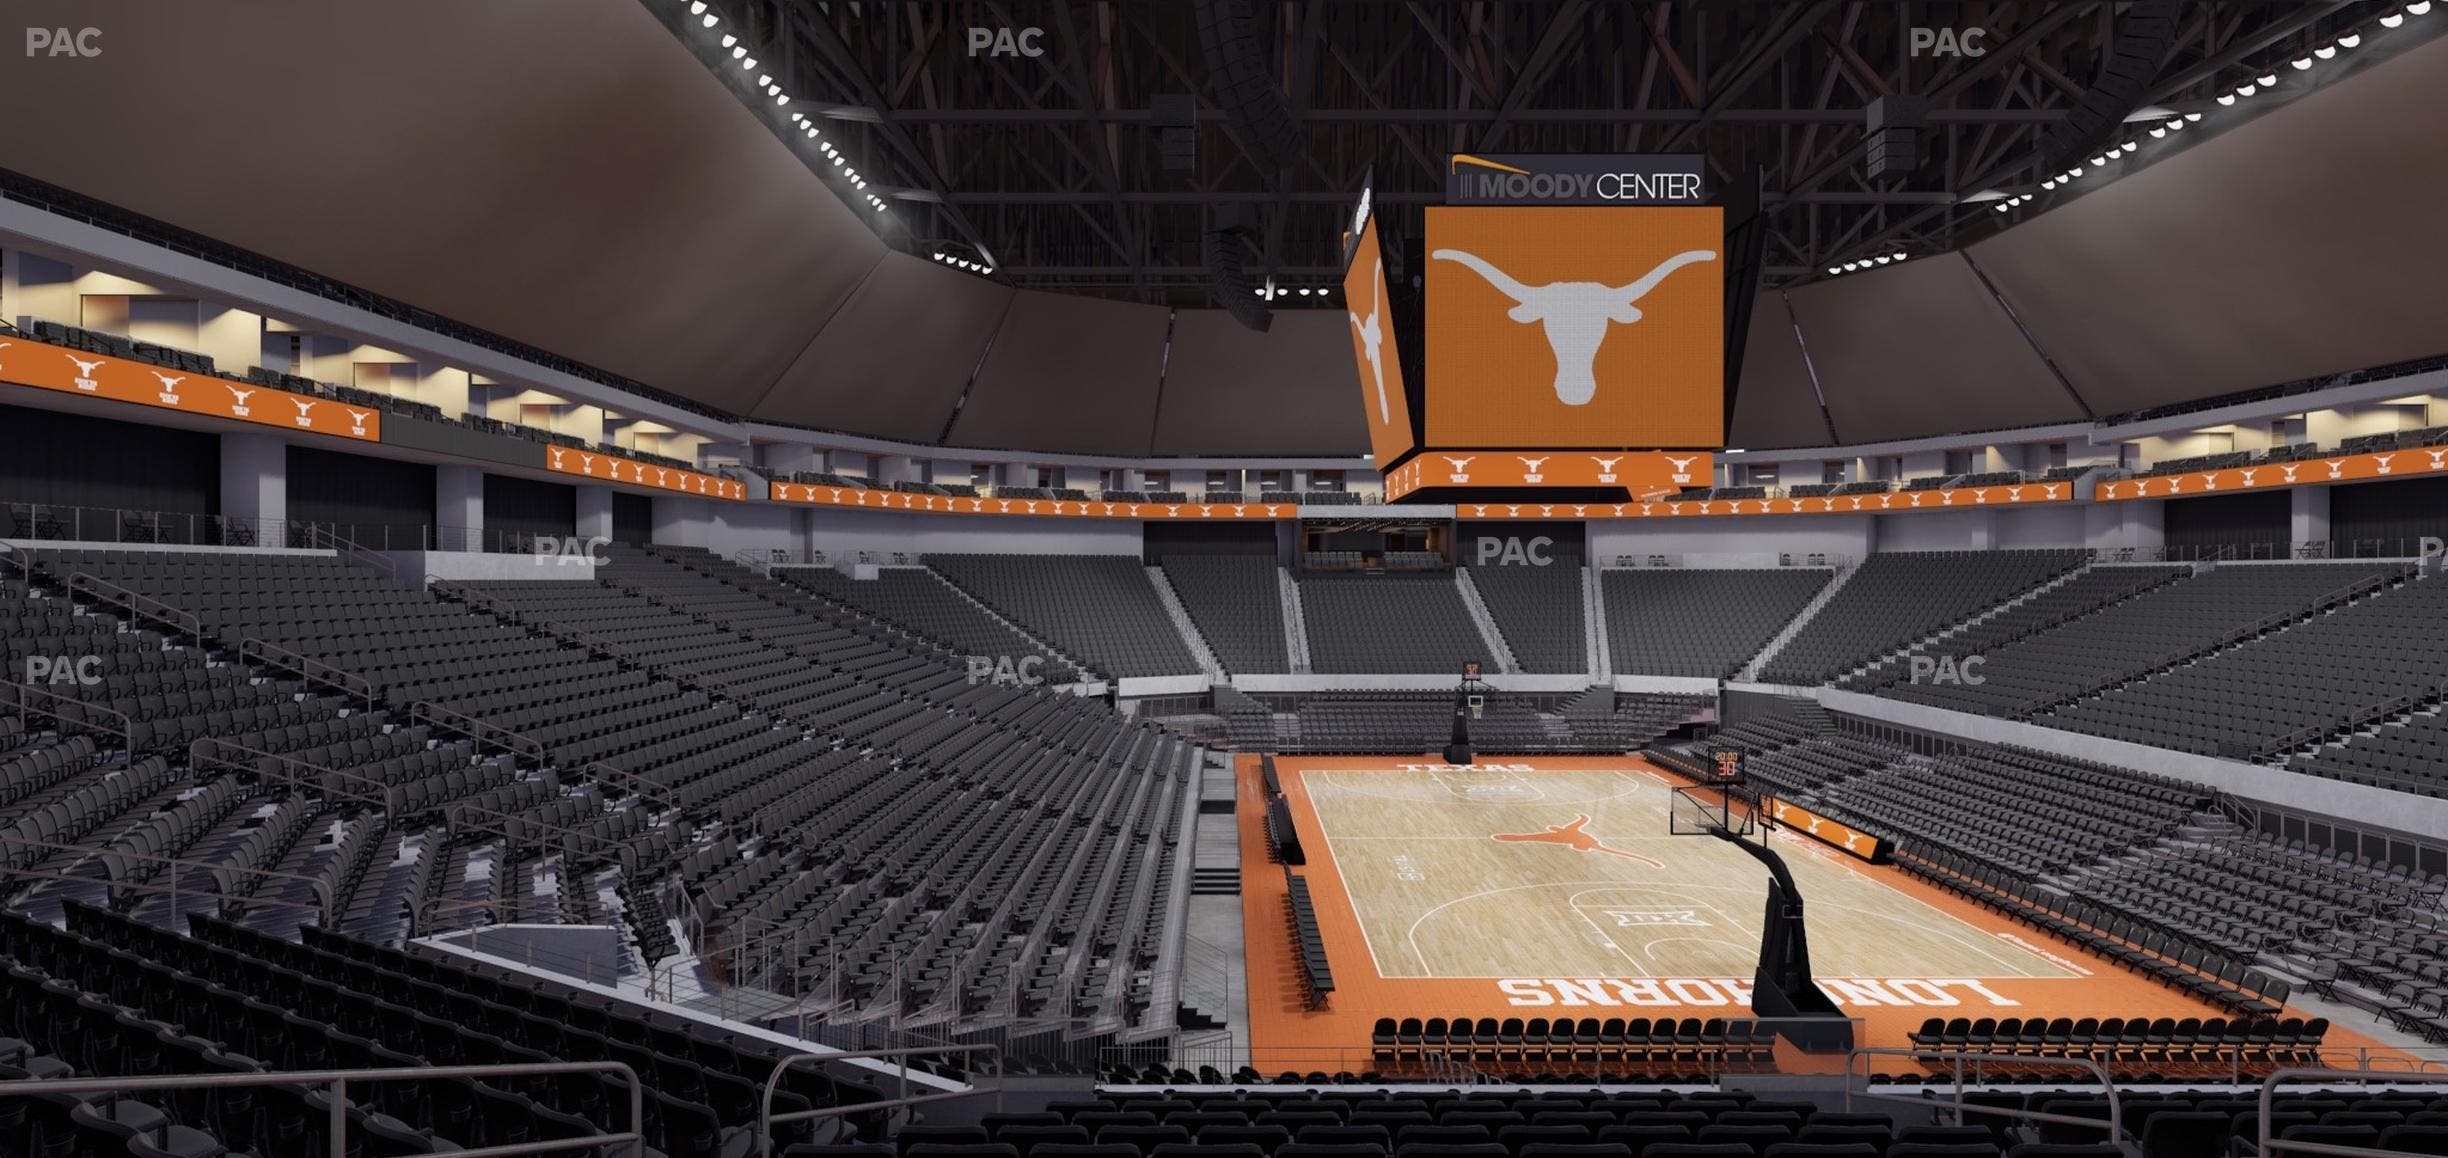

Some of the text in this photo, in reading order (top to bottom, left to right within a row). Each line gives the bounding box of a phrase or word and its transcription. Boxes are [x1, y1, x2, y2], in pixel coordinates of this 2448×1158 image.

[1479, 173, 1701, 199] MOODY CENTER
[1714, 752, 1738, 762] 20:00
[1396, 764, 1536, 773] TEXAS
[1717, 761, 1736, 776] 30
